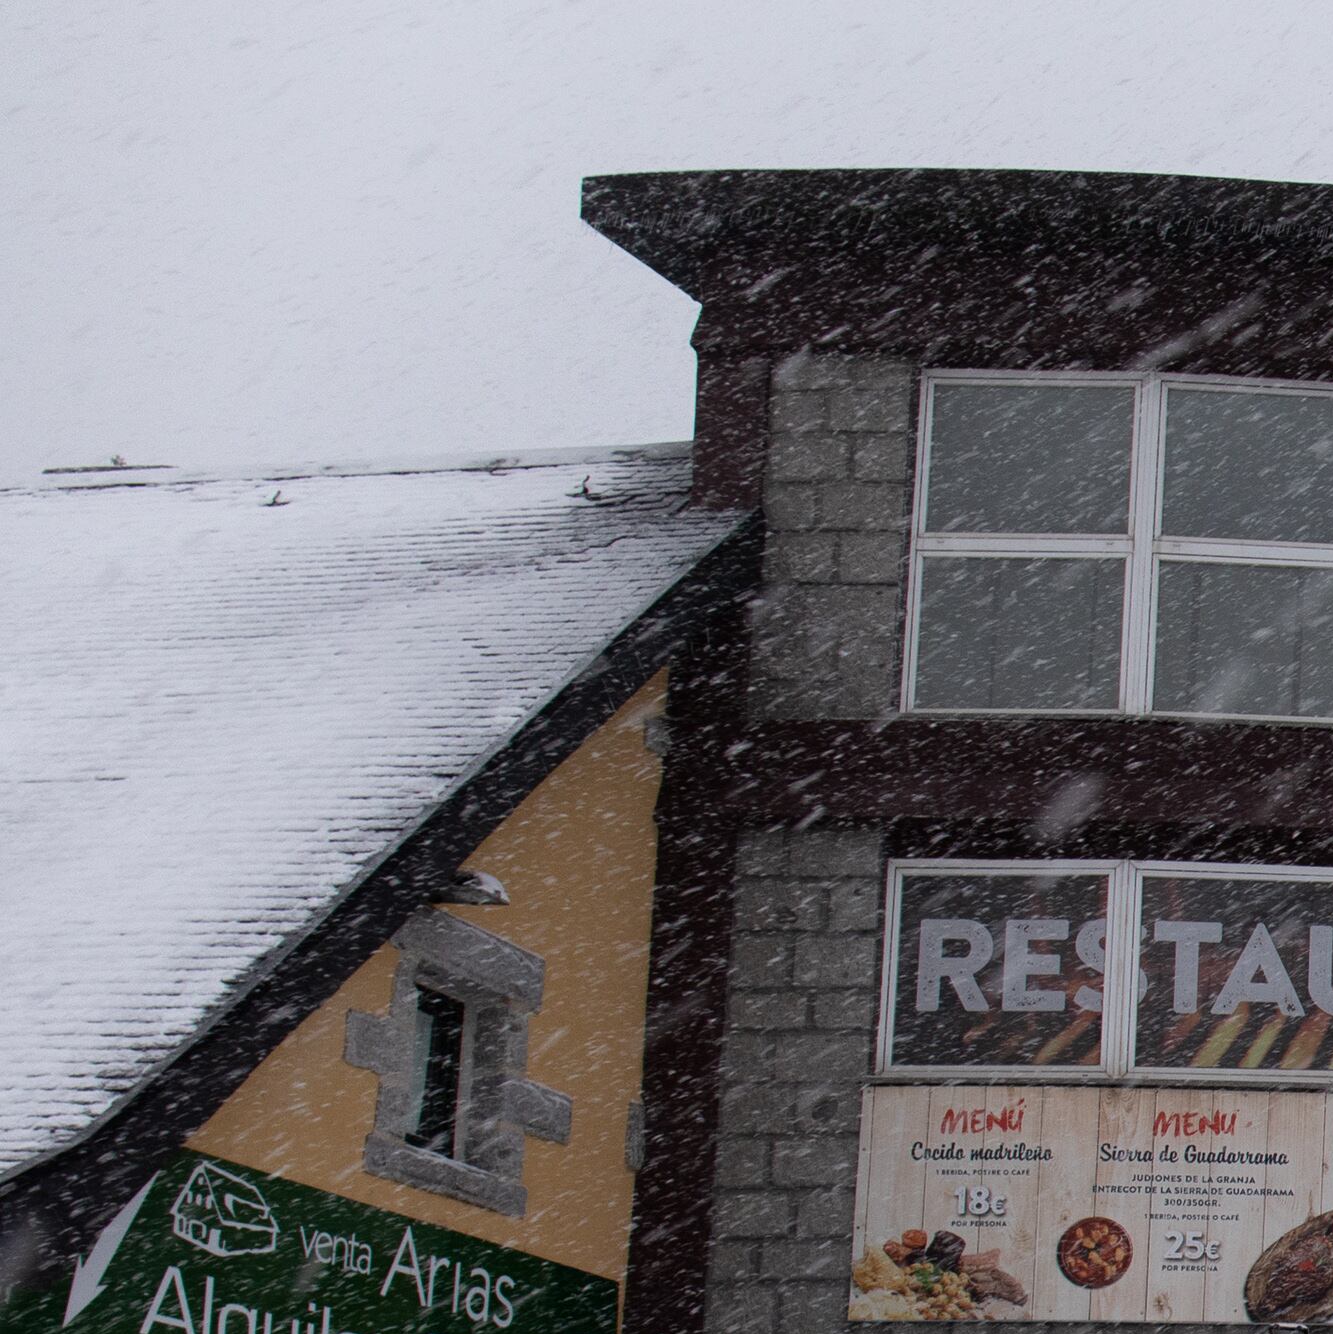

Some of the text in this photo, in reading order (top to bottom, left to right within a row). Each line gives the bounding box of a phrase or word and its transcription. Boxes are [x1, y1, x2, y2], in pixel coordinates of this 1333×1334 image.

[940, 1098, 1026, 1135] MENÚ
[911, 1141, 1053, 1161] Cocido madrileño
[1099, 1143, 1290, 1165] Sierra de Guadarrama
[1092, 1185, 1142, 1194] ENTRECOT
[1160, 1186, 1172, 1195] LA
[1174, 1186, 1208, 1195] SIERRA
[1226, 1187, 1294, 1196] GUADARRAMA
[1132, 1174, 1256, 1185] JUDIONES DE LA GRANJA
[953, 1184, 1007, 1216] 18€
[1163, 1231, 1221, 1262] 25€
[300, 1226, 516, 1328] venta Arias
